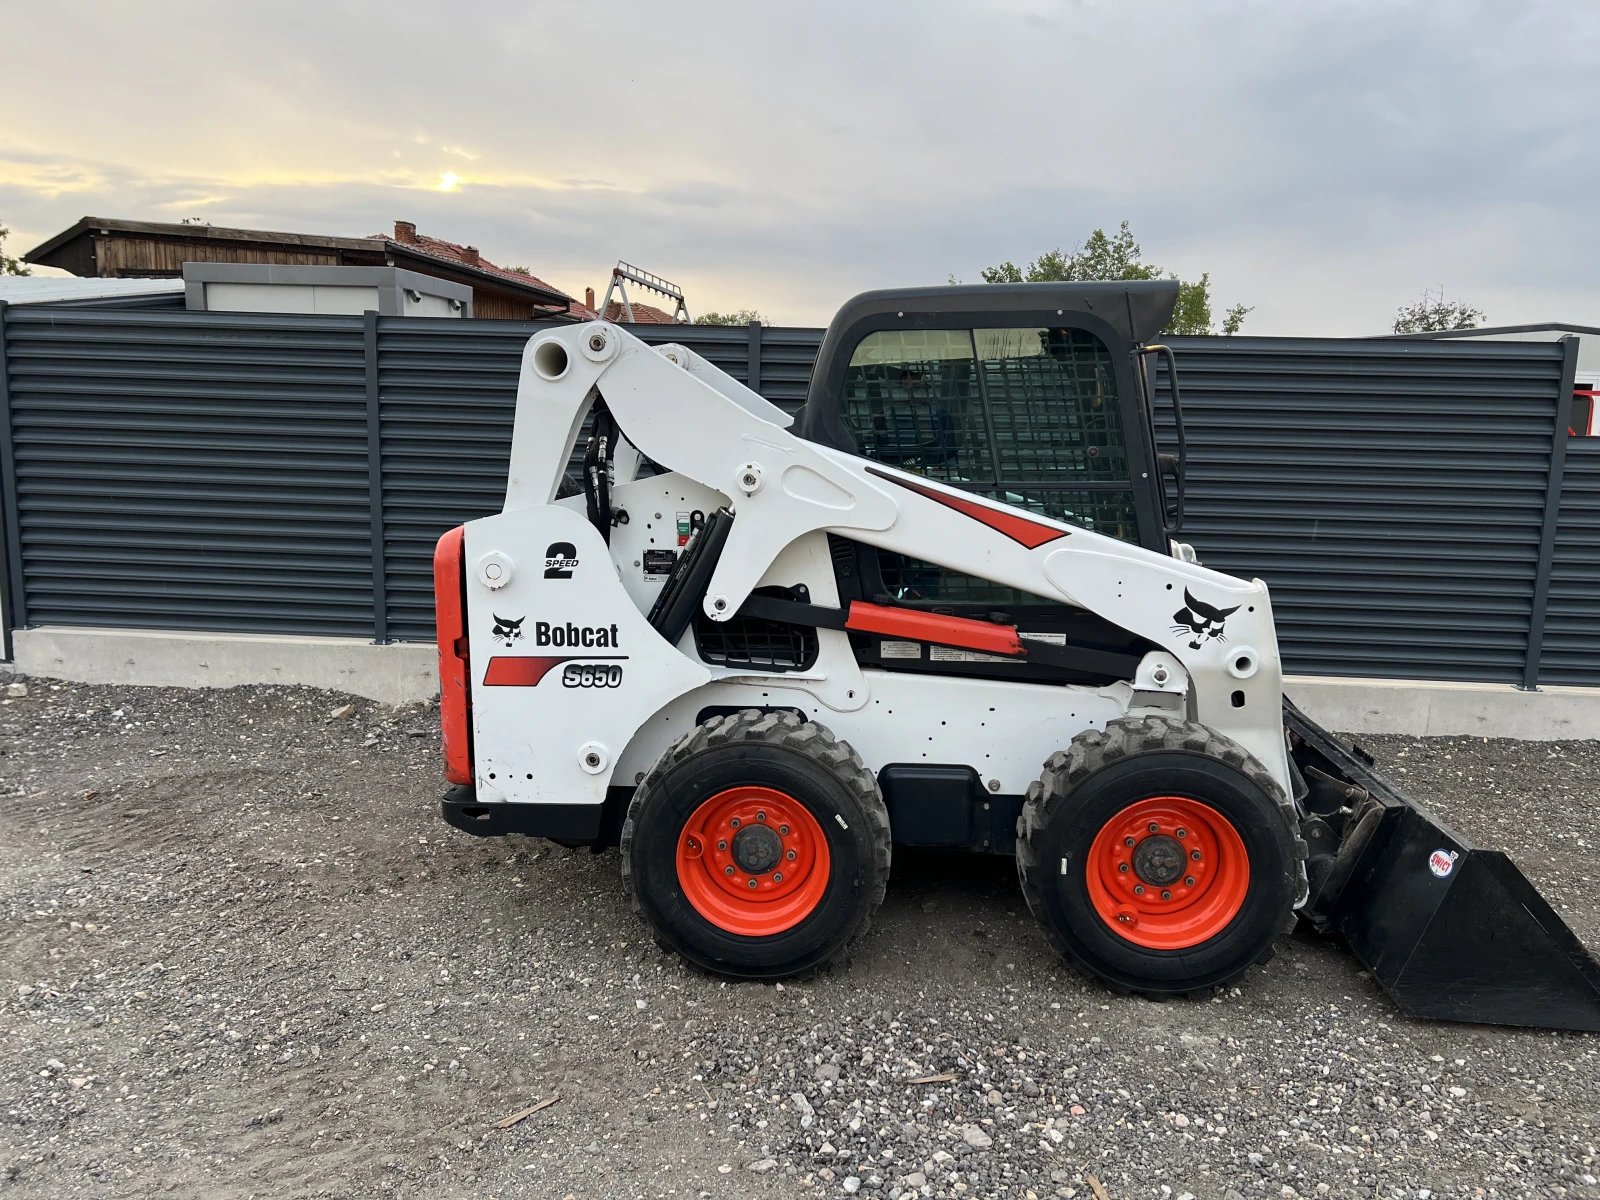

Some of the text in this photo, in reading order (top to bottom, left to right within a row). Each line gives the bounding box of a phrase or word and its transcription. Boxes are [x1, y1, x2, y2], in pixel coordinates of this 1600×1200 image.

[544, 541, 577, 579] 2
[545, 559, 579, 567] SPEED
[535, 621, 619, 648] Bobcat
[562, 664, 623, 689] S650
[1430, 853, 1452, 873] SWICT
